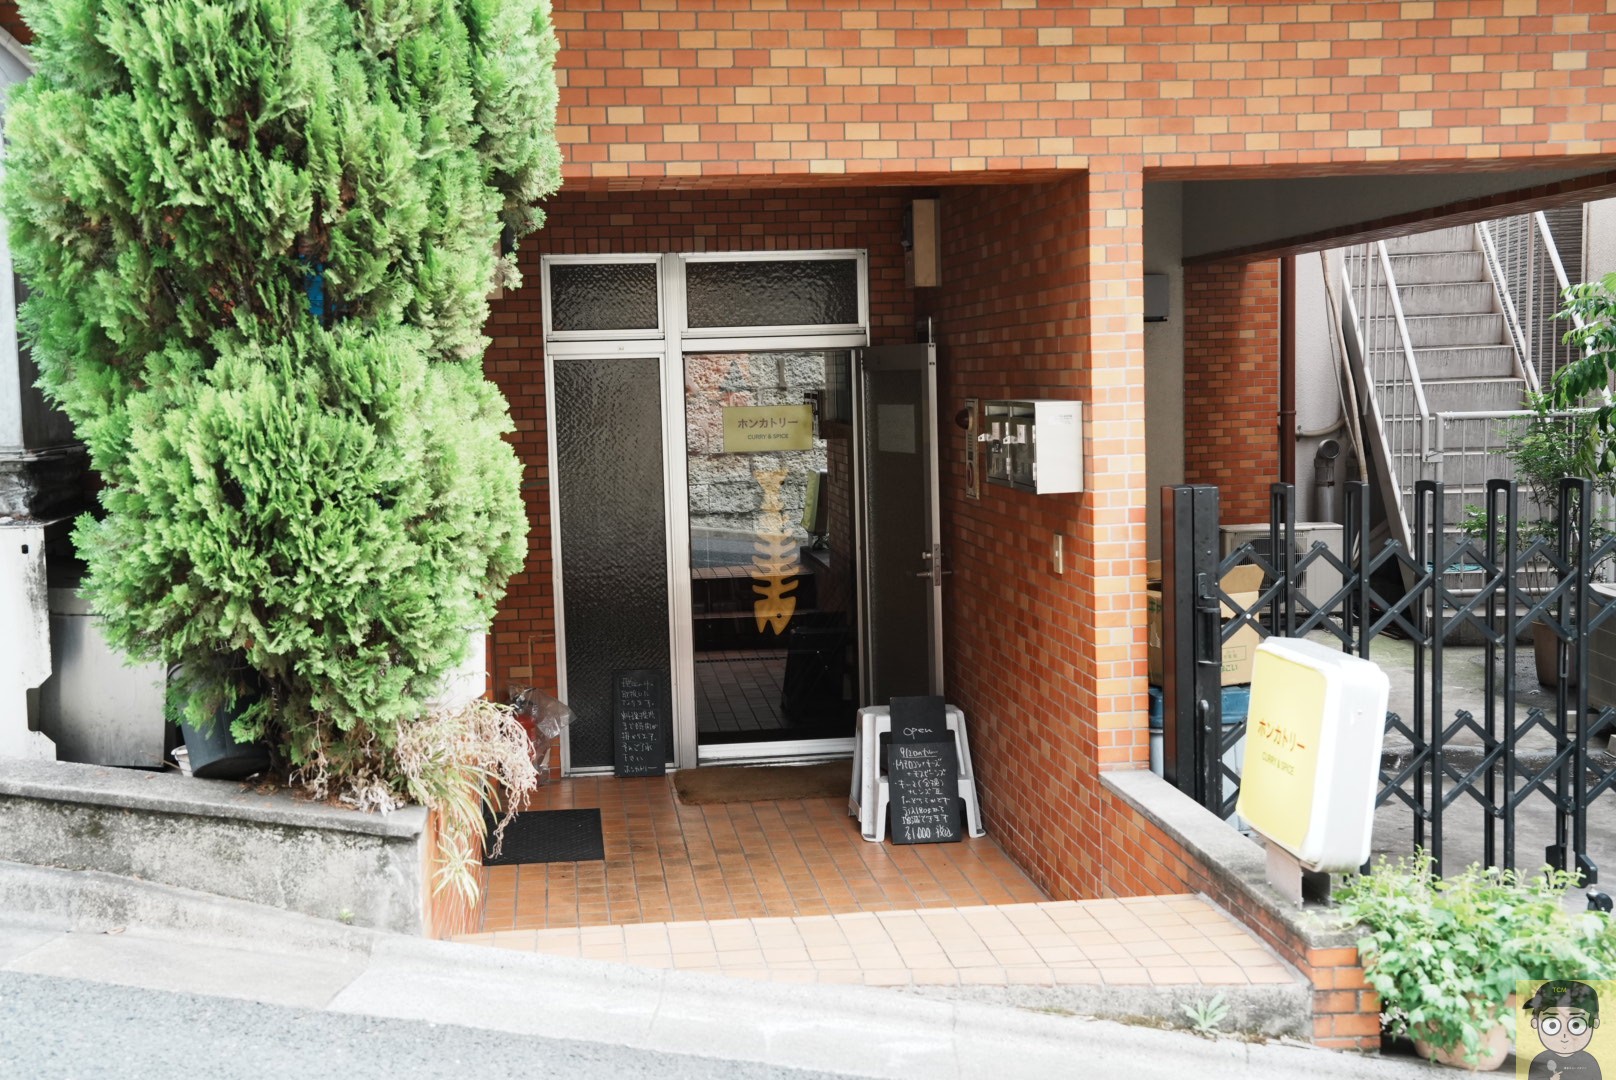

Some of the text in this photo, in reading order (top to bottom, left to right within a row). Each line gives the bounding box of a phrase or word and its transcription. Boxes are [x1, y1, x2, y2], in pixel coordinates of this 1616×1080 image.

[738, 418, 799, 429] ホンカトリー
[1257, 719, 1305, 752] ホンカトリー
[1262, 752, 1276, 765] CURRY
[1281, 761, 1295, 775] SPICE
